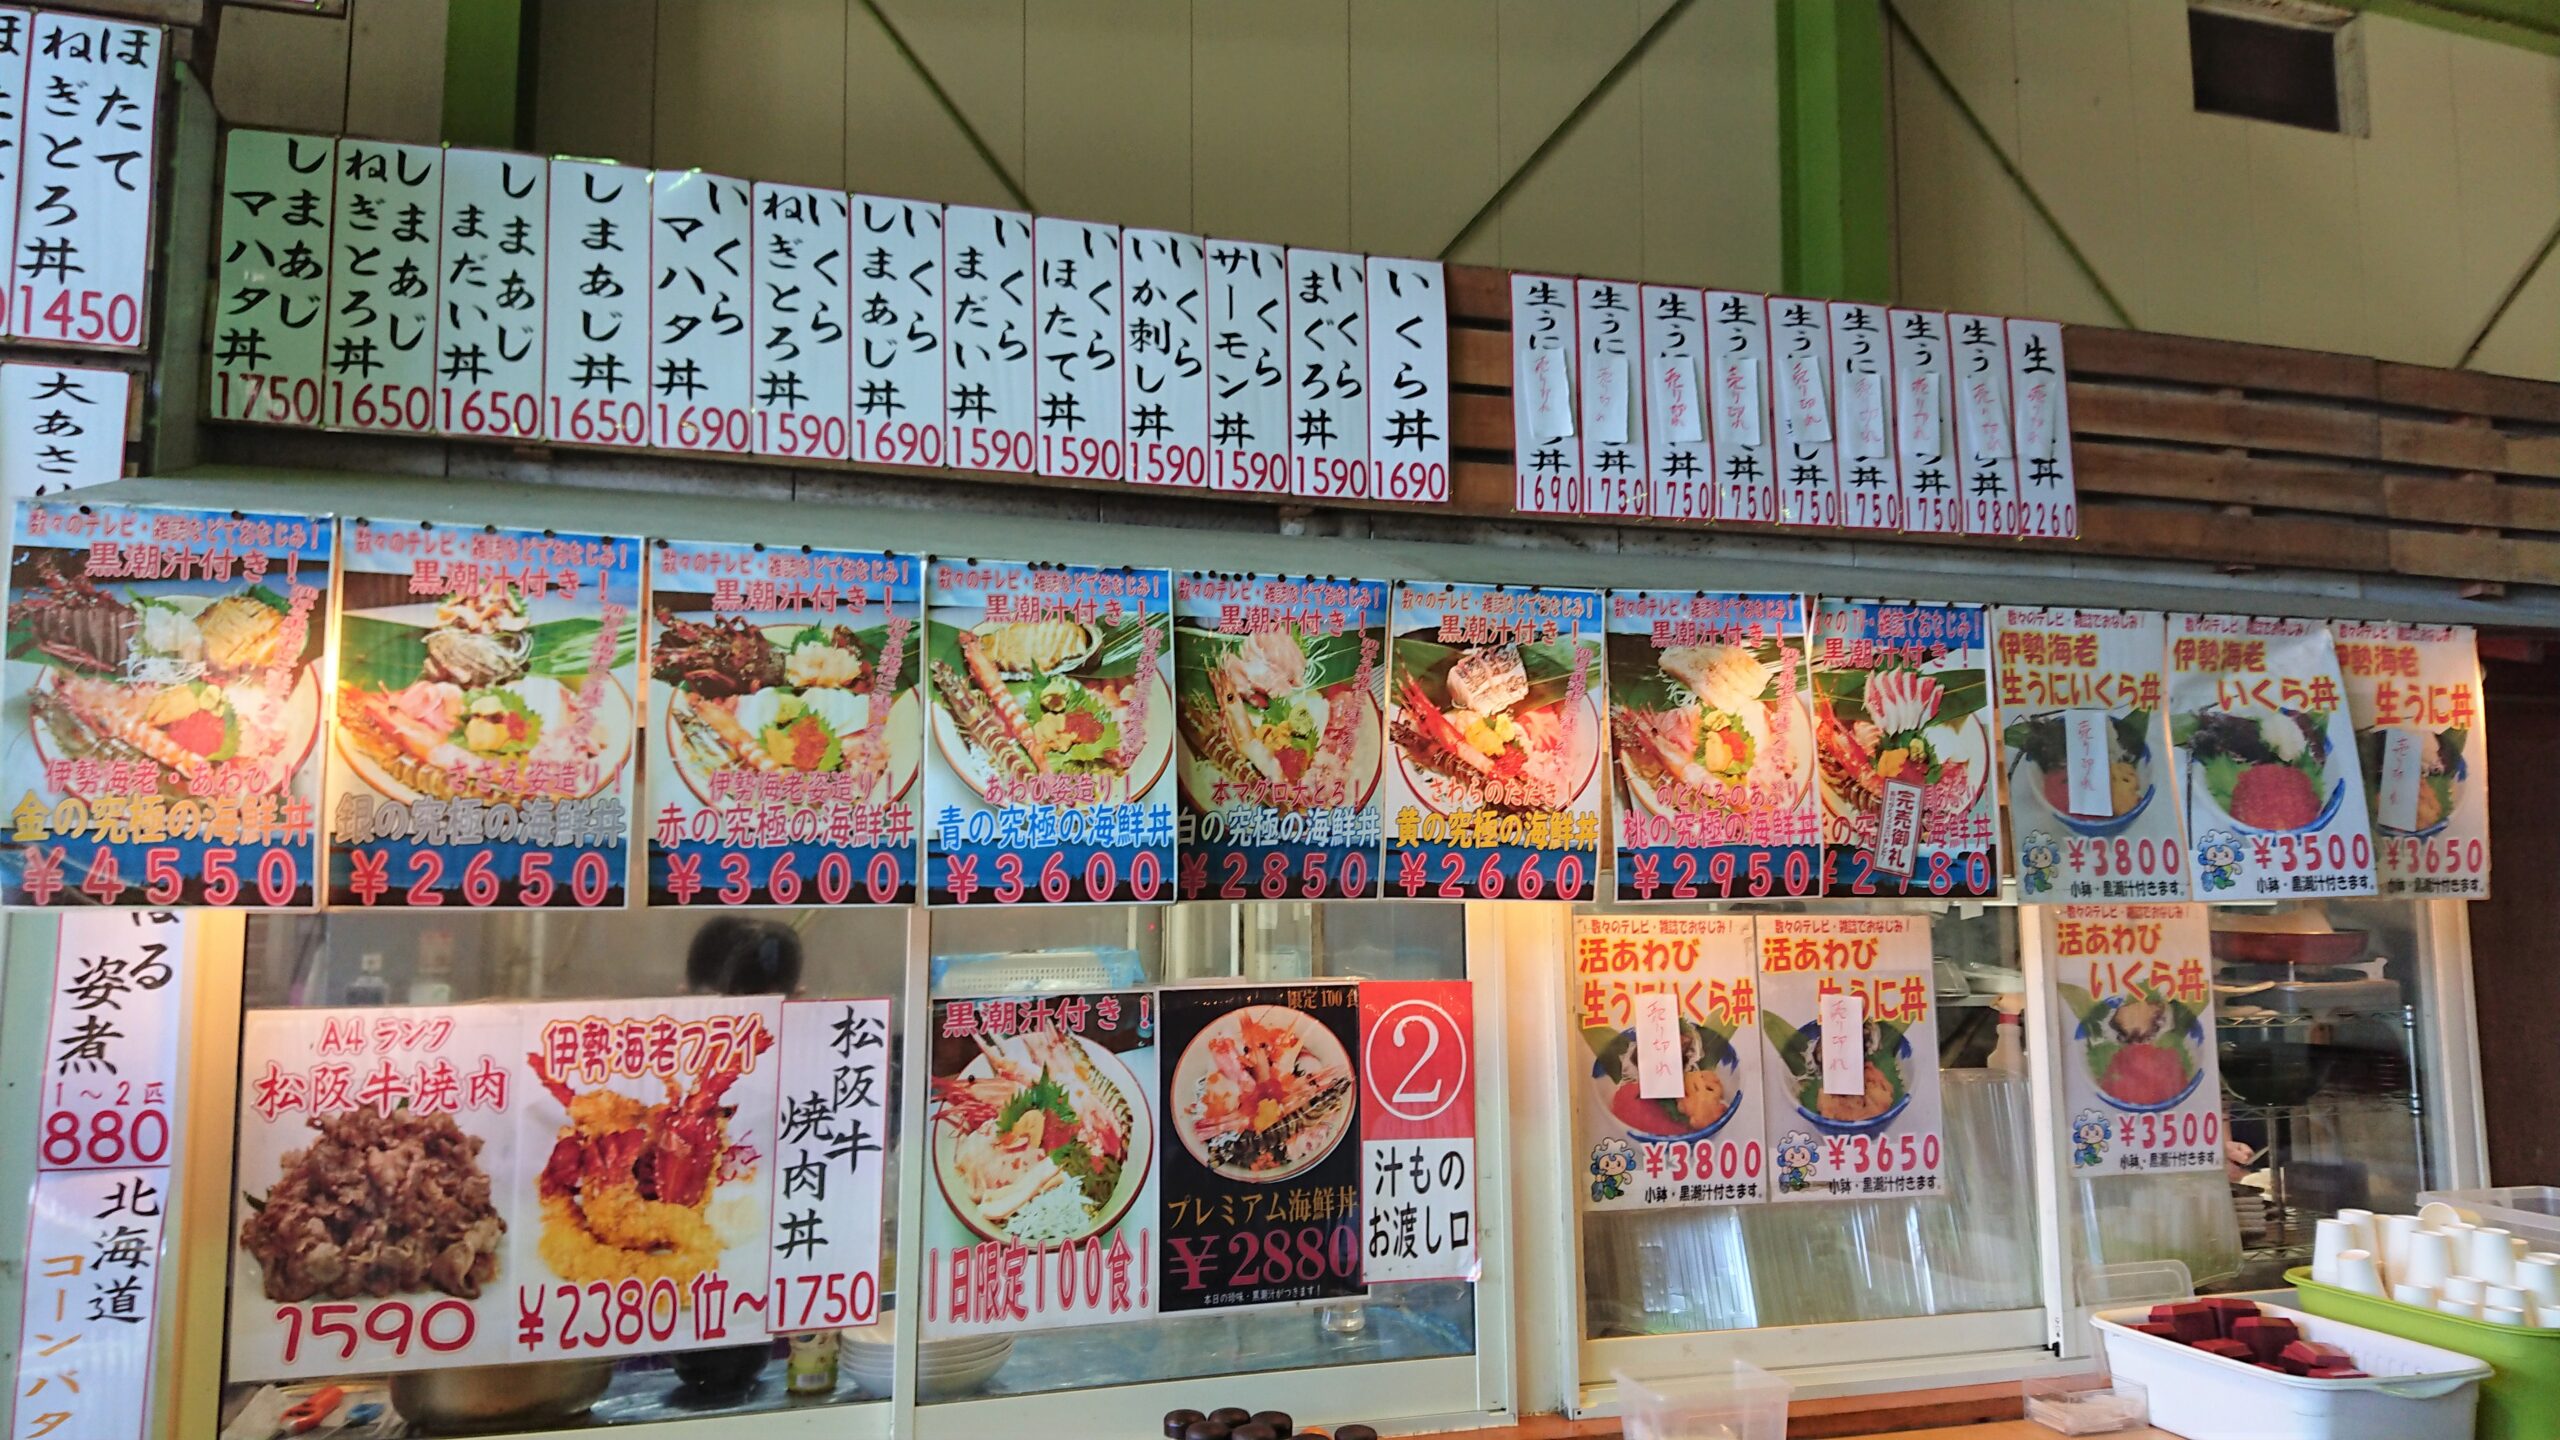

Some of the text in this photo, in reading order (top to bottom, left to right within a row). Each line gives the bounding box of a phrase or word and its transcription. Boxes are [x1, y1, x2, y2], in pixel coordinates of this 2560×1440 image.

[98, 27, 151, 191] ほたて
[20, 28, 93, 284] ねぎとろ丼
[278, 138, 327, 329] しまあじ
[388, 150, 432, 352] しまあじ
[709, 180, 748, 335] いくら
[215, 191, 277, 370] マハタ丼
[330, 150, 388, 379] ねぎとろ丼
[496, 162, 536, 364] しまあじ
[570, 173, 632, 395] しまあじ丼
[807, 193, 846, 343] いくら
[903, 204, 941, 352] いくら
[994, 215, 1030, 360] いくら
[19, 290, 137, 343] 1450
[441, 205, 494, 386] まだい丼
[654, 218, 709, 400] マハタ丼
[757, 191, 809, 410] ねぎとろ丼
[856, 202, 906, 418] しまあじ丼
[1082, 228, 1117, 370] いくら
[1169, 237, 1203, 378] いくら
[1250, 248, 1283, 386] いくら
[949, 247, 998, 423] まだい丼
[1039, 258, 1085, 433] ほたて丼
[1128, 237, 1173, 441] いか刺し丼
[1211, 248, 1254, 449] サーモン丼
[1331, 263, 1363, 398] いくら
[1295, 270, 1338, 449] まぐろ丼
[1383, 269, 1440, 452] いくら丼
[218, 371, 317, 424] 1750
[332, 380, 431, 429] 1650
[441, 388, 539, 437] 1650
[550, 396, 645, 445] 1650
[657, 404, 749, 450] 1690
[758, 411, 846, 457] 1590
[857, 419, 941, 465] 1690
[954, 426, 1033, 470] 1590
[1043, 435, 1121, 478] 1590
[1130, 442, 1205, 485] 1590
[1215, 450, 1287, 491] 1590
[1297, 456, 1367, 496] 1590
[1375, 460, 1446, 499] 1690
[1520, 475, 1578, 510] 1690
[1587, 476, 1644, 513] 1750
[1652, 480, 1710, 516] 1750
[1719, 484, 1772, 520] 1750
[1782, 490, 1835, 524] 1750
[1844, 492, 1897, 527] 1750
[1906, 497, 1958, 530] 1750
[1966, 500, 2016, 532] 1980
[2022, 502, 2073, 535] 2260
[1999, 631, 2097, 667] 伊勢海老
[2174, 638, 2266, 673] 伊勢海老
[2002, 669, 2162, 711] 生うにいくら丼
[2217, 676, 2341, 712] いくら丼
[2376, 682, 2475, 728] 生うに丼
[12, 789, 314, 846] 金の究極の海鮮丼
[335, 792, 627, 848] 銀の究極の海鮮丼
[656, 803, 914, 849] 赤の究極の海鮮丼
[937, 804, 1174, 849] 青の究極の海鮮丼
[1177, 806, 1380, 848] 白の究極の海鮮丼
[1396, 806, 1599, 851] 黄の究極の海鮮丼
[1623, 809, 1819, 850] 桃の究極の海鮮丼
[24, 847, 297, 906] ¥4550
[351, 849, 609, 906] ¥2650
[667, 852, 899, 905] ¥3600
[947, 851, 1160, 903] ¥3600
[1181, 852, 1368, 899] ¥2850
[1399, 852, 1583, 899] ¥2660
[1634, 852, 1809, 899] ¥2950
[2068, 837, 2180, 877] ¥3800
[2253, 833, 2370, 872] ¥3500
[2384, 838, 2484, 874] ¥3650
[1579, 938, 1700, 974] 活あわび
[1762, 938, 1878, 972] 活あわび
[2058, 922, 2161, 956] 活あわび
[2089, 959, 2206, 1001] いくら丼
[57, 956, 131, 1076] 姿煮
[543, 1013, 767, 1084] 伊勢海老フライ
[253, 1058, 510, 1122] 松阪牛焼肉
[823, 1005, 885, 1175] 松阪牛
[42, 1109, 169, 1167] 880
[1827, 1133, 1941, 1172] ¥3650
[2119, 1112, 2219, 1150] ¥3500
[774, 1090, 835, 1261] 焼肉丼
[1375, 1145, 1465, 1198] 汁もの
[1644, 1140, 1761, 1181] ¥3800
[1168, 1185, 1358, 1231] プレミアム海鮮丼
[1369, 1208, 1470, 1260] お渡し口
[86, 1176, 160, 1323] 北海道
[1168, 1224, 1357, 1291] ¥2880
[776, 1272, 874, 1327] 1750
[275, 1297, 477, 1363] 1590
